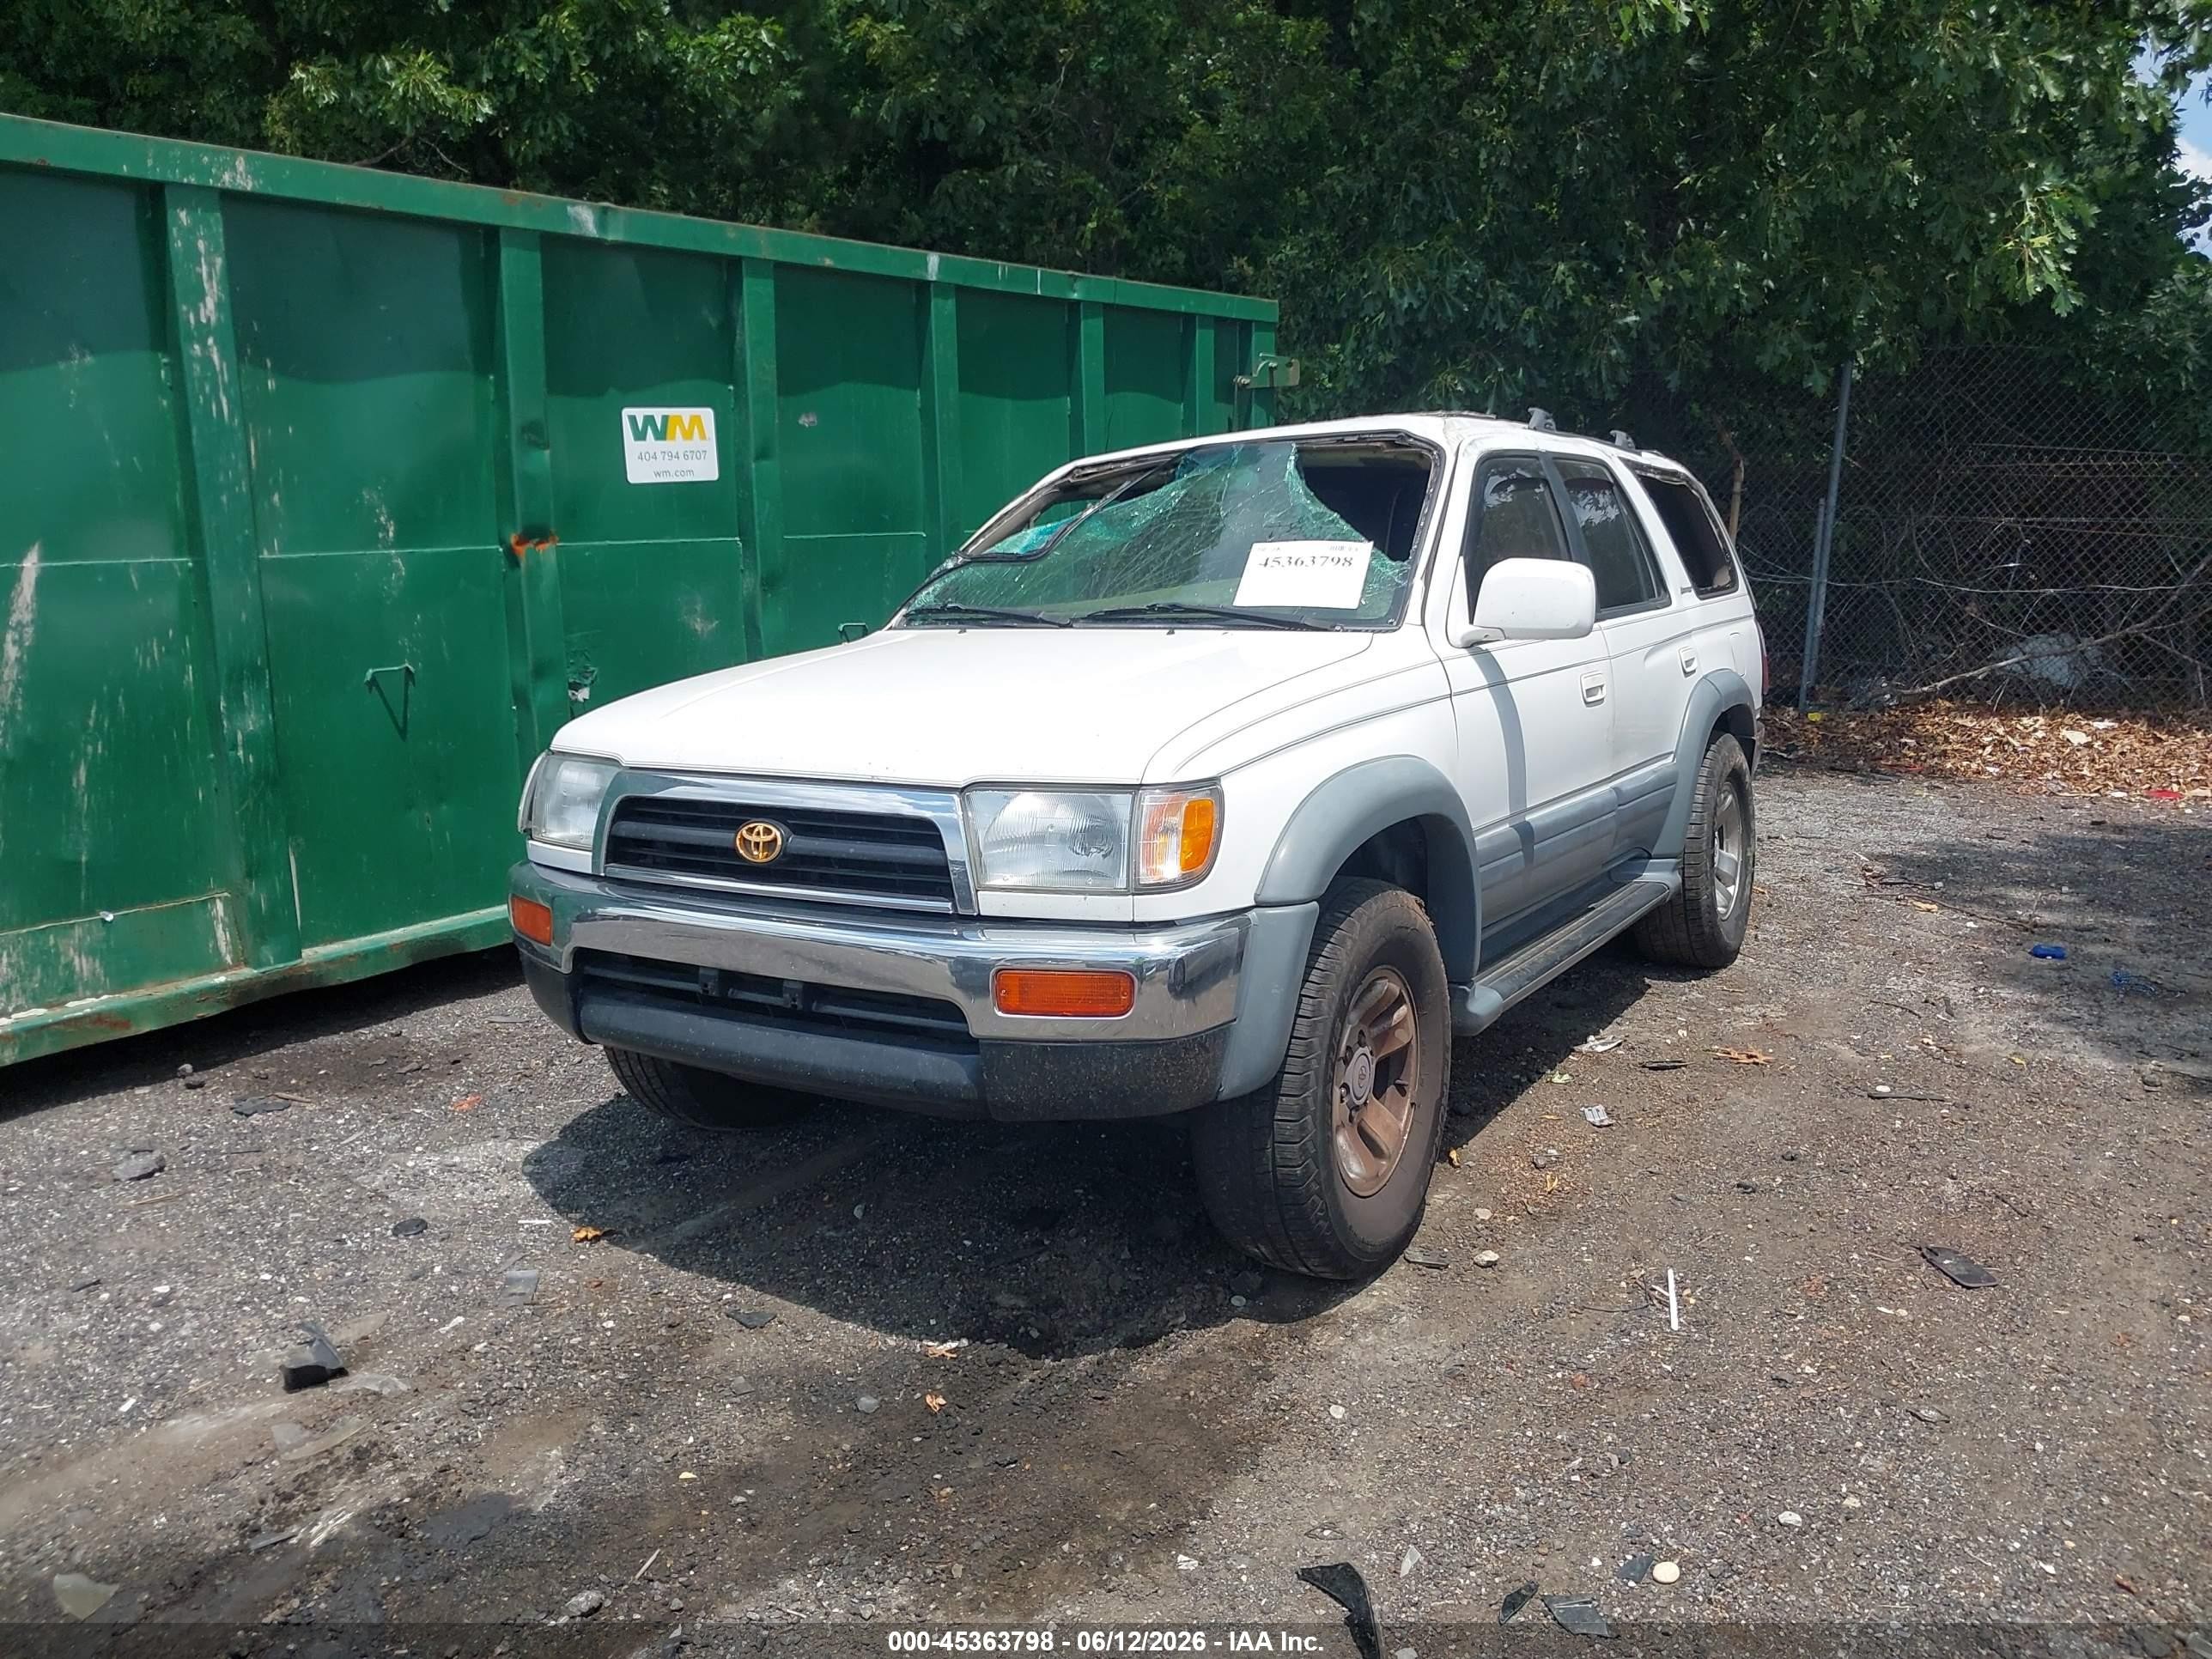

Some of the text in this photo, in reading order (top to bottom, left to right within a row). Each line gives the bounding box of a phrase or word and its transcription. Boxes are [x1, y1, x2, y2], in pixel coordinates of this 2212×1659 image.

[627, 415, 708, 441] WM
[637, 450, 708, 462] 404 794 6707
[653, 469, 695, 478] wm.com
[1258, 556, 1354, 568] 45363798
